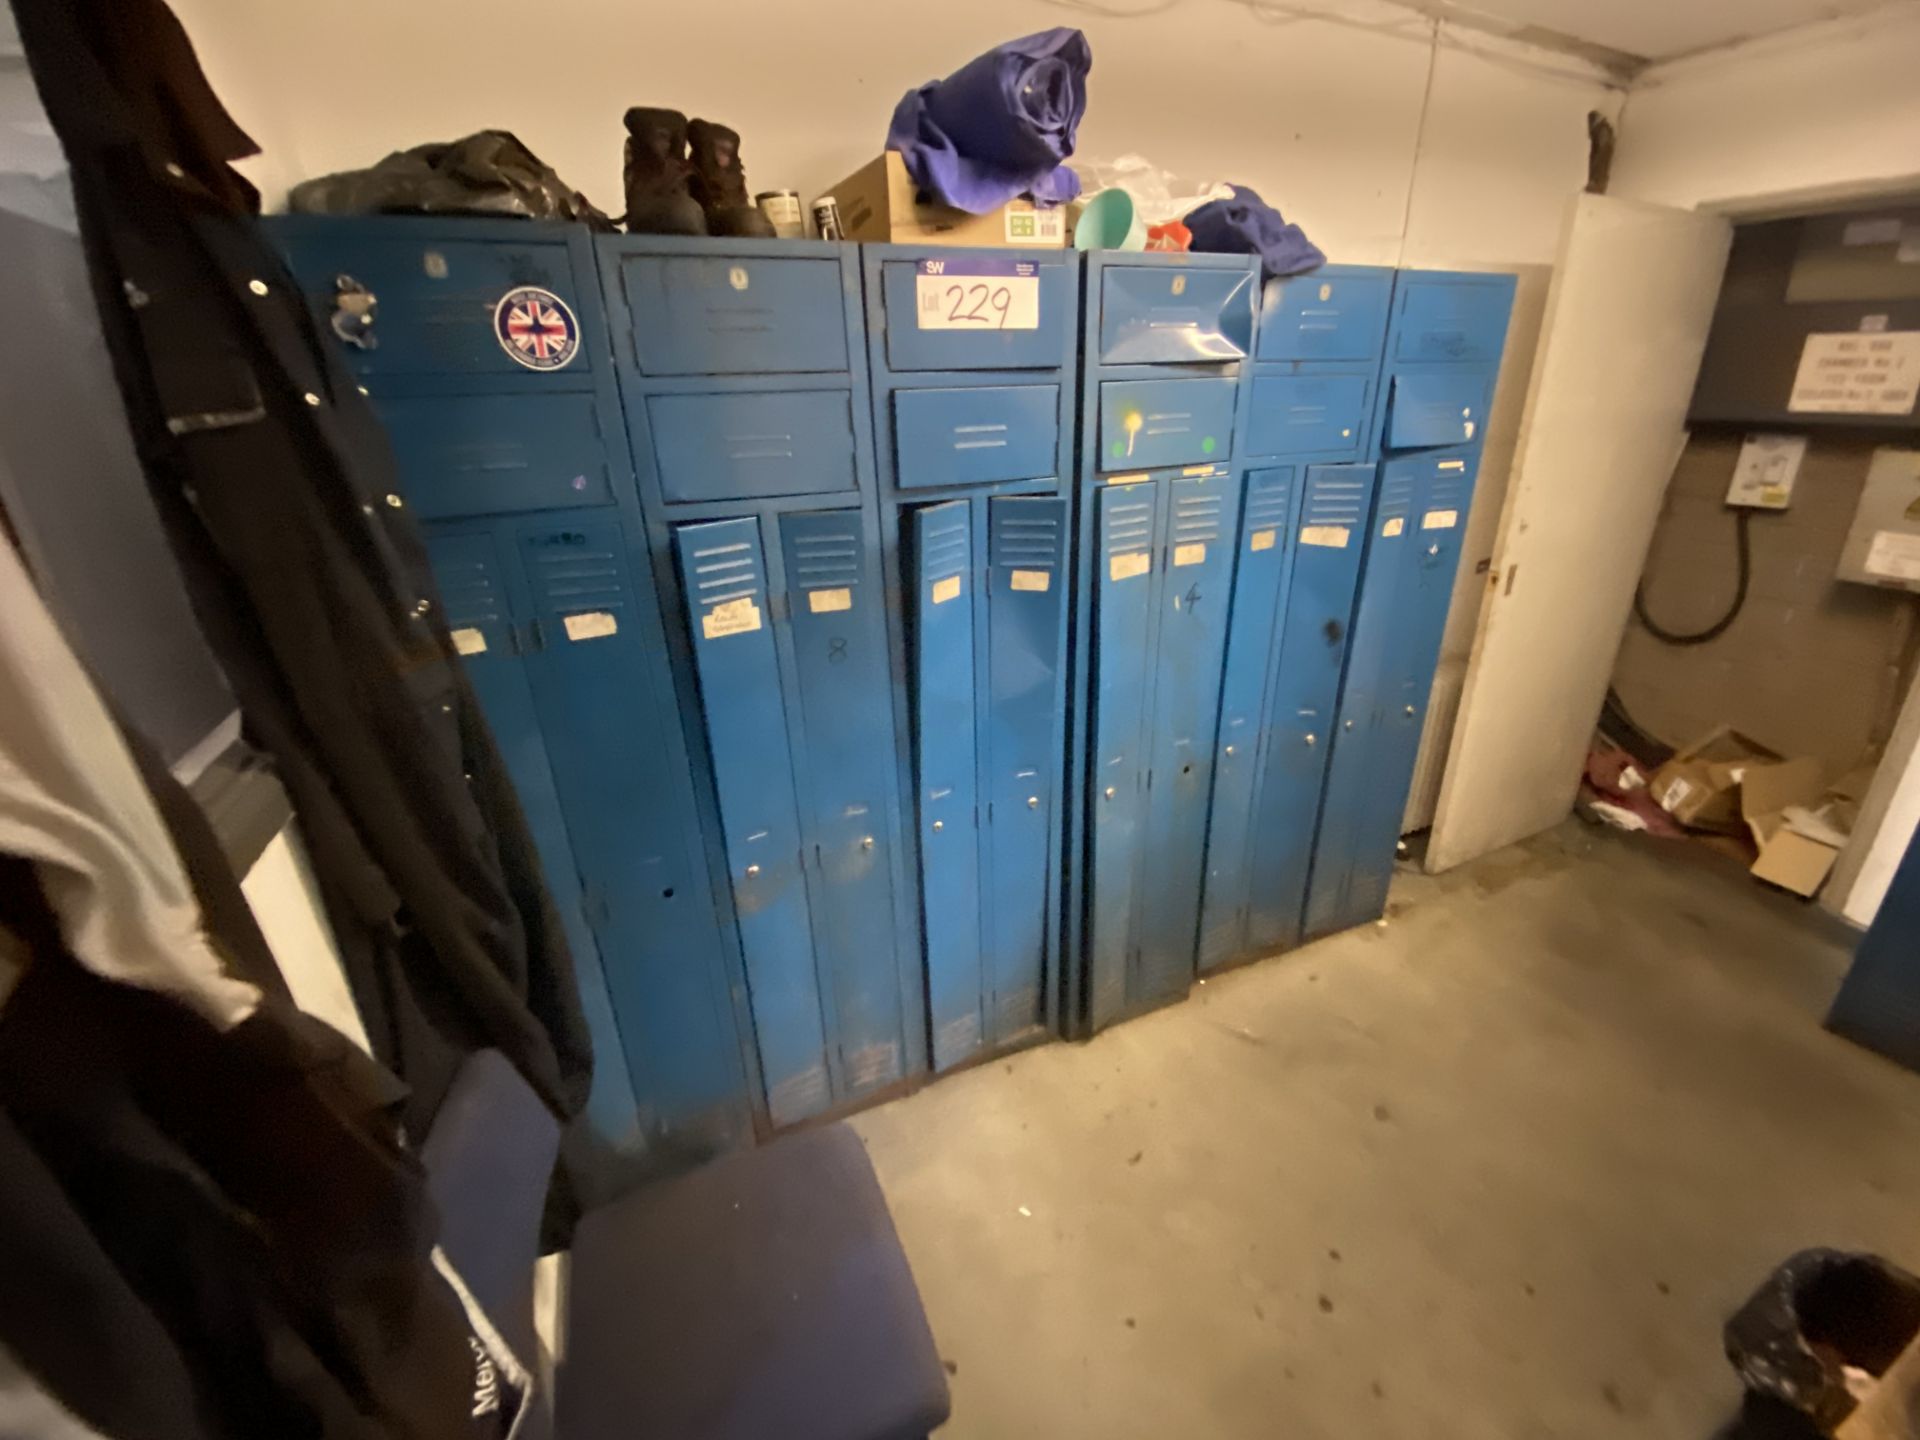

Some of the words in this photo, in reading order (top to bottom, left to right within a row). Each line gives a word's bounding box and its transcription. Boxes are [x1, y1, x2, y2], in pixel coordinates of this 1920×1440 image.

[926, 260, 945, 275] SW
[946, 283, 1012, 330] 229
[1184, 581, 1203, 616] 4
[828, 637, 848, 664] 8
